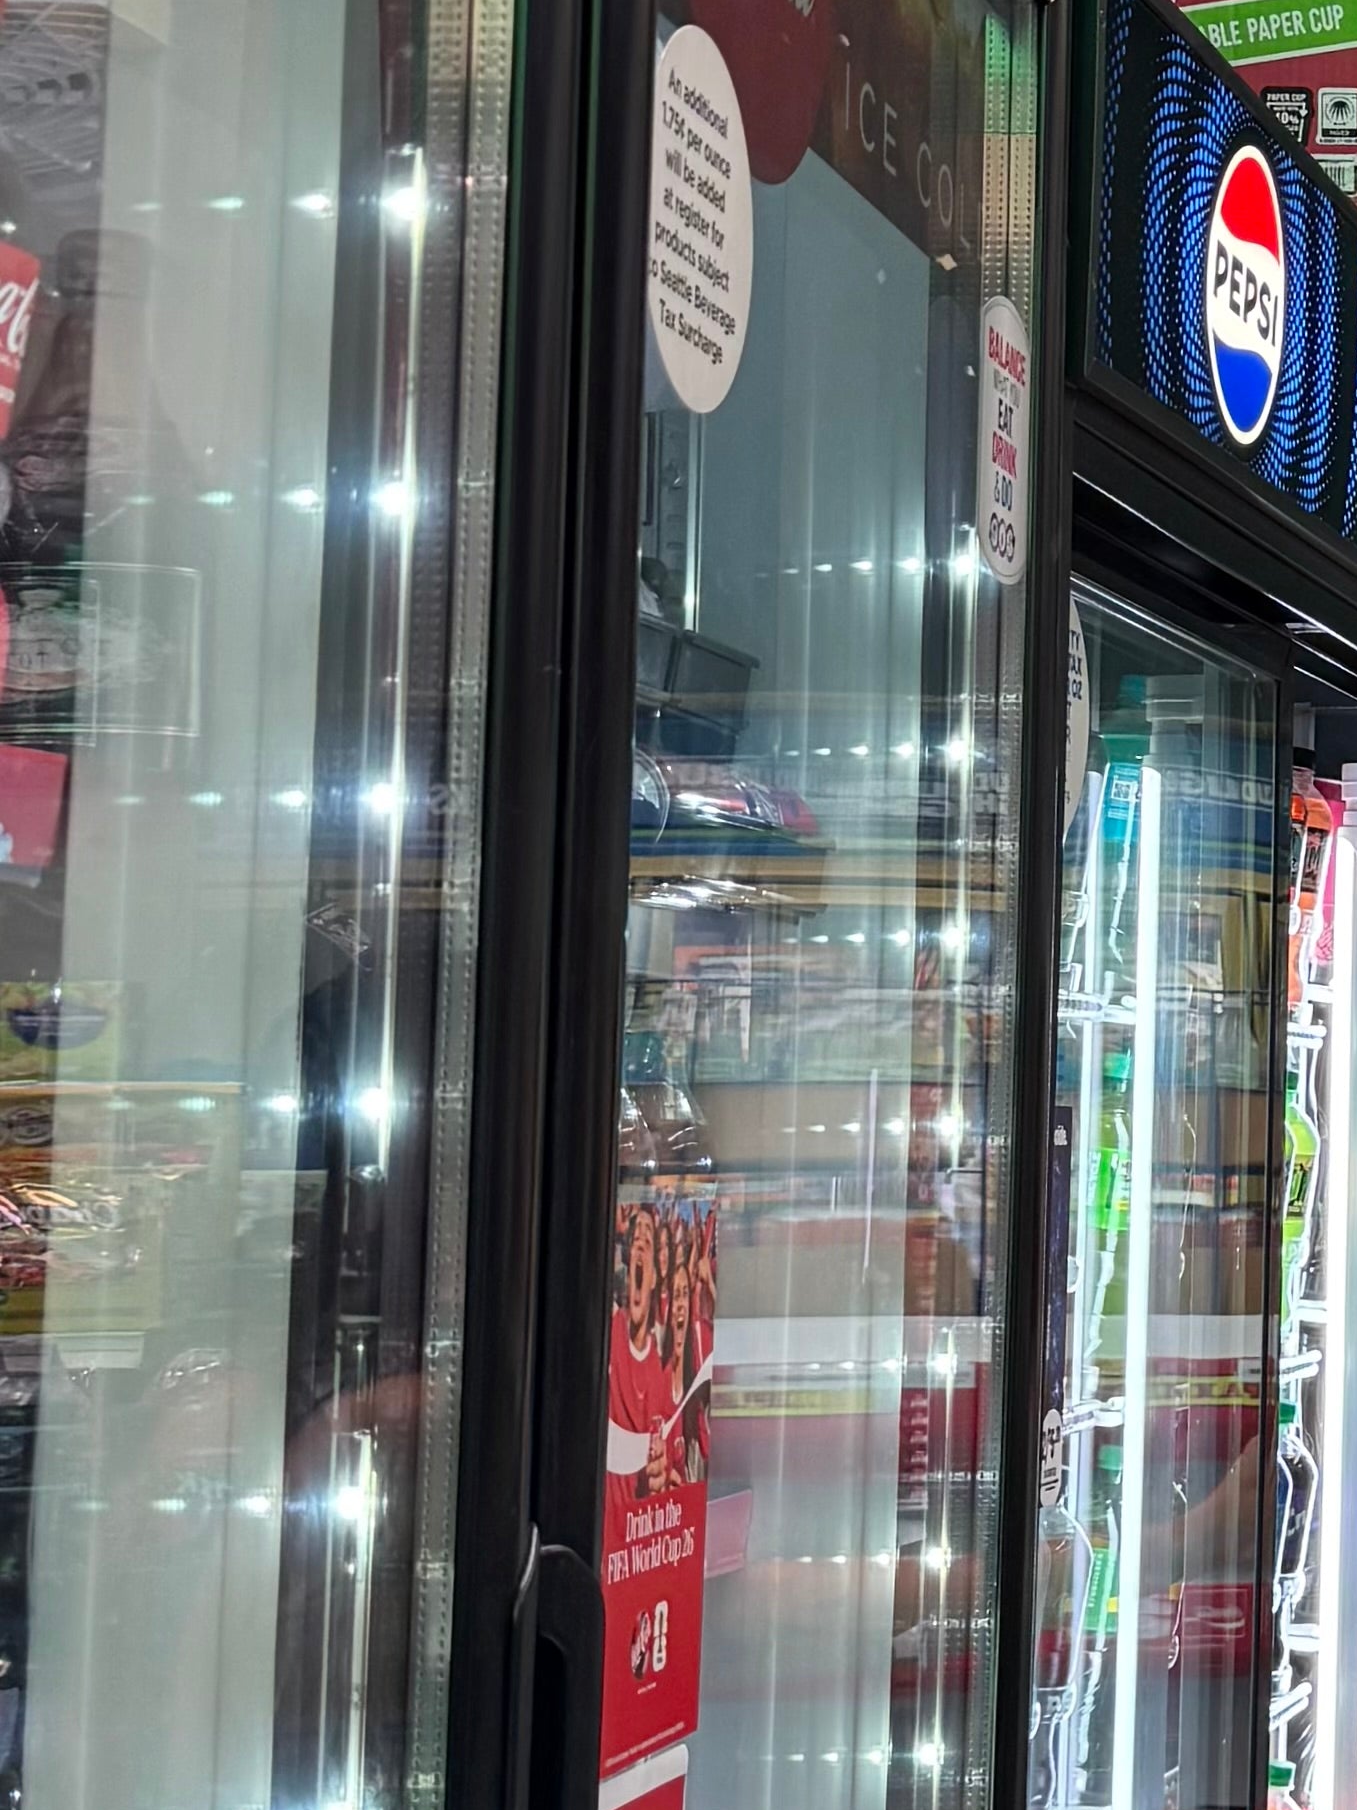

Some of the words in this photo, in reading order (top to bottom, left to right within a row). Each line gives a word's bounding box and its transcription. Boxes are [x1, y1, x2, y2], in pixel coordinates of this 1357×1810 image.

[1247, 12, 1304, 43] PAPER
[1309, 5, 1343, 33] CUP
[668, 67, 681, 95] An
[683, 80, 729, 139] additional
[665, 148, 682, 179] will
[684, 159, 695, 187] be
[697, 172, 725, 213] added
[687, 127, 702, 156] per
[704, 144, 730, 179] ounce
[664, 187, 674, 211] at
[675, 195, 710, 236] register
[711, 221, 724, 250] for
[655, 220, 695, 266] products
[698, 251, 729, 293] subject
[660, 263, 692, 303] Seattle
[695, 285, 735, 335] Beverage
[1212, 240, 1279, 347] PEPSI
[659, 299, 677, 332] Tax
[679, 312, 723, 365] Surcharge
[989, 326, 1026, 387] BALANCE
[998, 399, 1014, 439] EAT
[992, 431, 1017, 479] DRINK
[626, 1506, 654, 1542] Drink
[654, 1504, 664, 1530] in
[666, 1498, 682, 1526] the
[608, 1554, 629, 1585] FIFA
[631, 1536, 662, 1575] World
[662, 1532, 679, 1567] Cup
